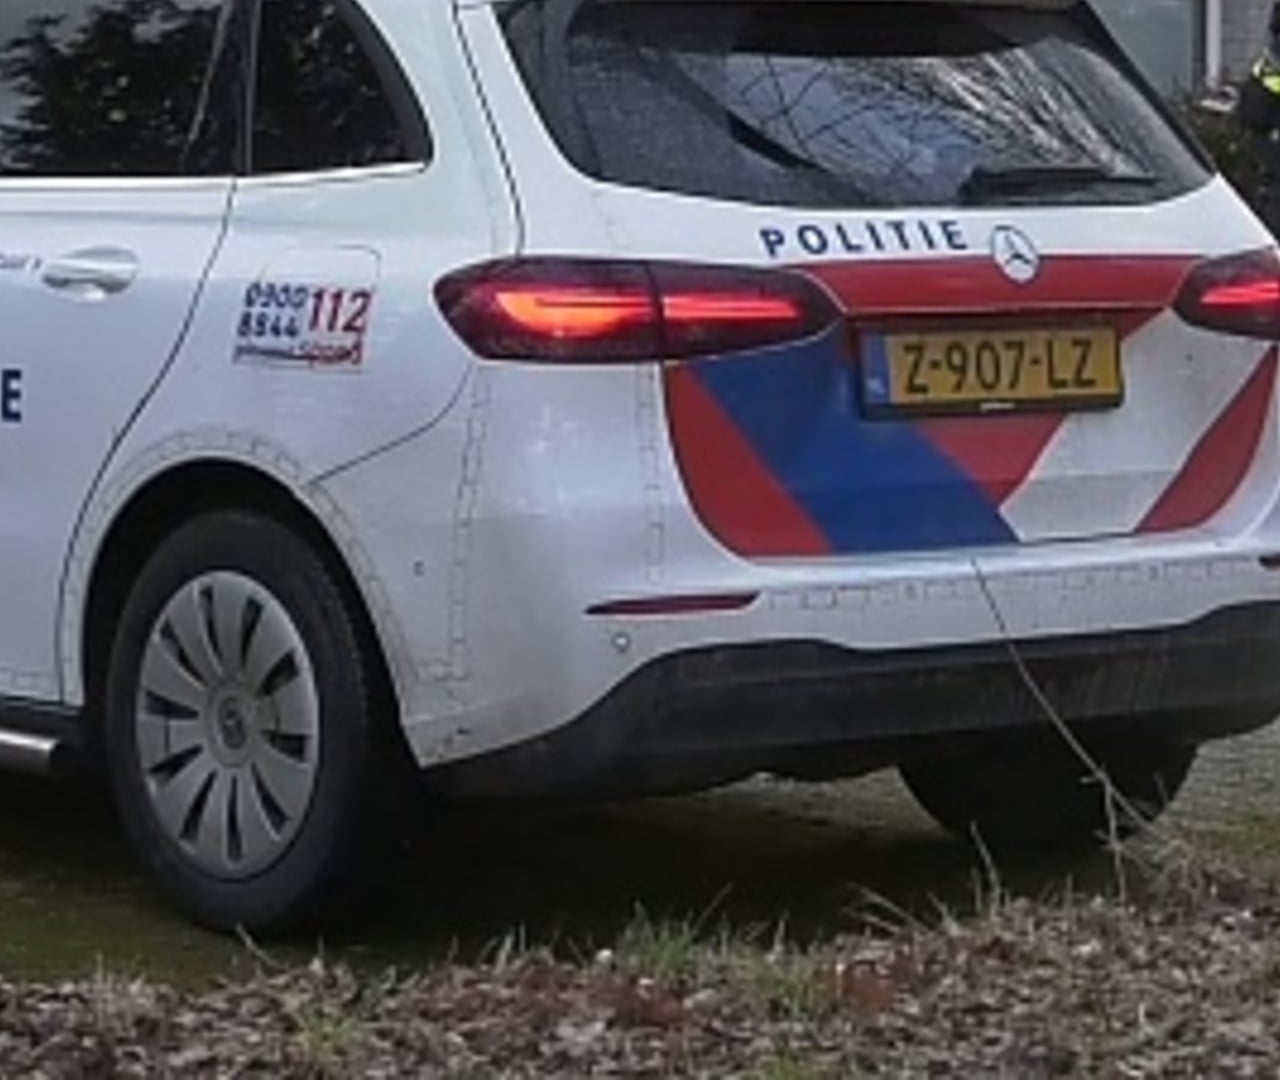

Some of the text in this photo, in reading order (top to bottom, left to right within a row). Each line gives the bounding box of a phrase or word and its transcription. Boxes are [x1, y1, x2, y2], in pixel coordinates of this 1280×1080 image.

[759, 220, 968, 257] POLITIE
[245, 282, 308, 308] 0900
[309, 288, 371, 332] 112
[903, 339, 1097, 394] Z-907-LZ
